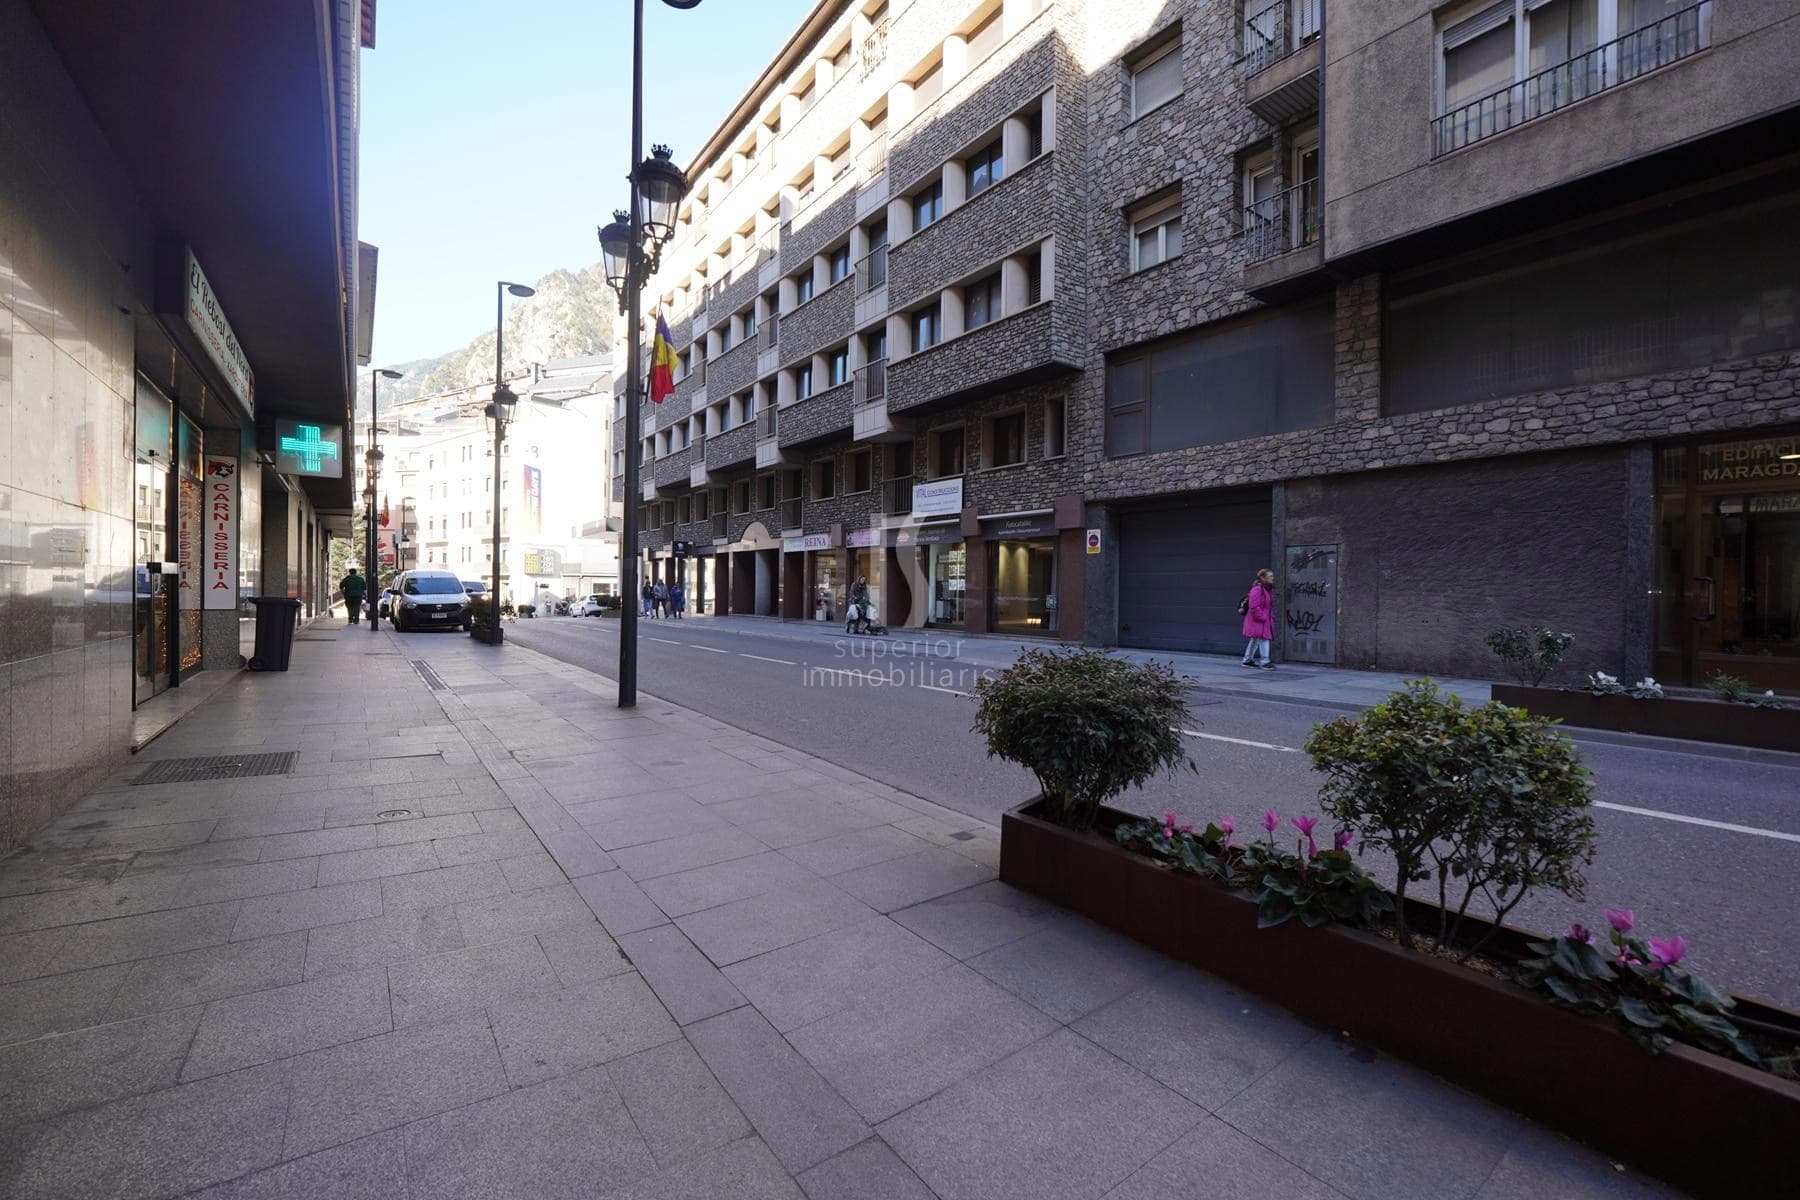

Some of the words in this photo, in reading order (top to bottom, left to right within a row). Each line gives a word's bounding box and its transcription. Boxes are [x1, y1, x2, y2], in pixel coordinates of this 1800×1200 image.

[190, 263, 200, 295] El
[225, 334, 237, 358] del
[1703, 463, 1800, 480] MARAGD
[213, 483, 230, 590] CARNISSERIA
